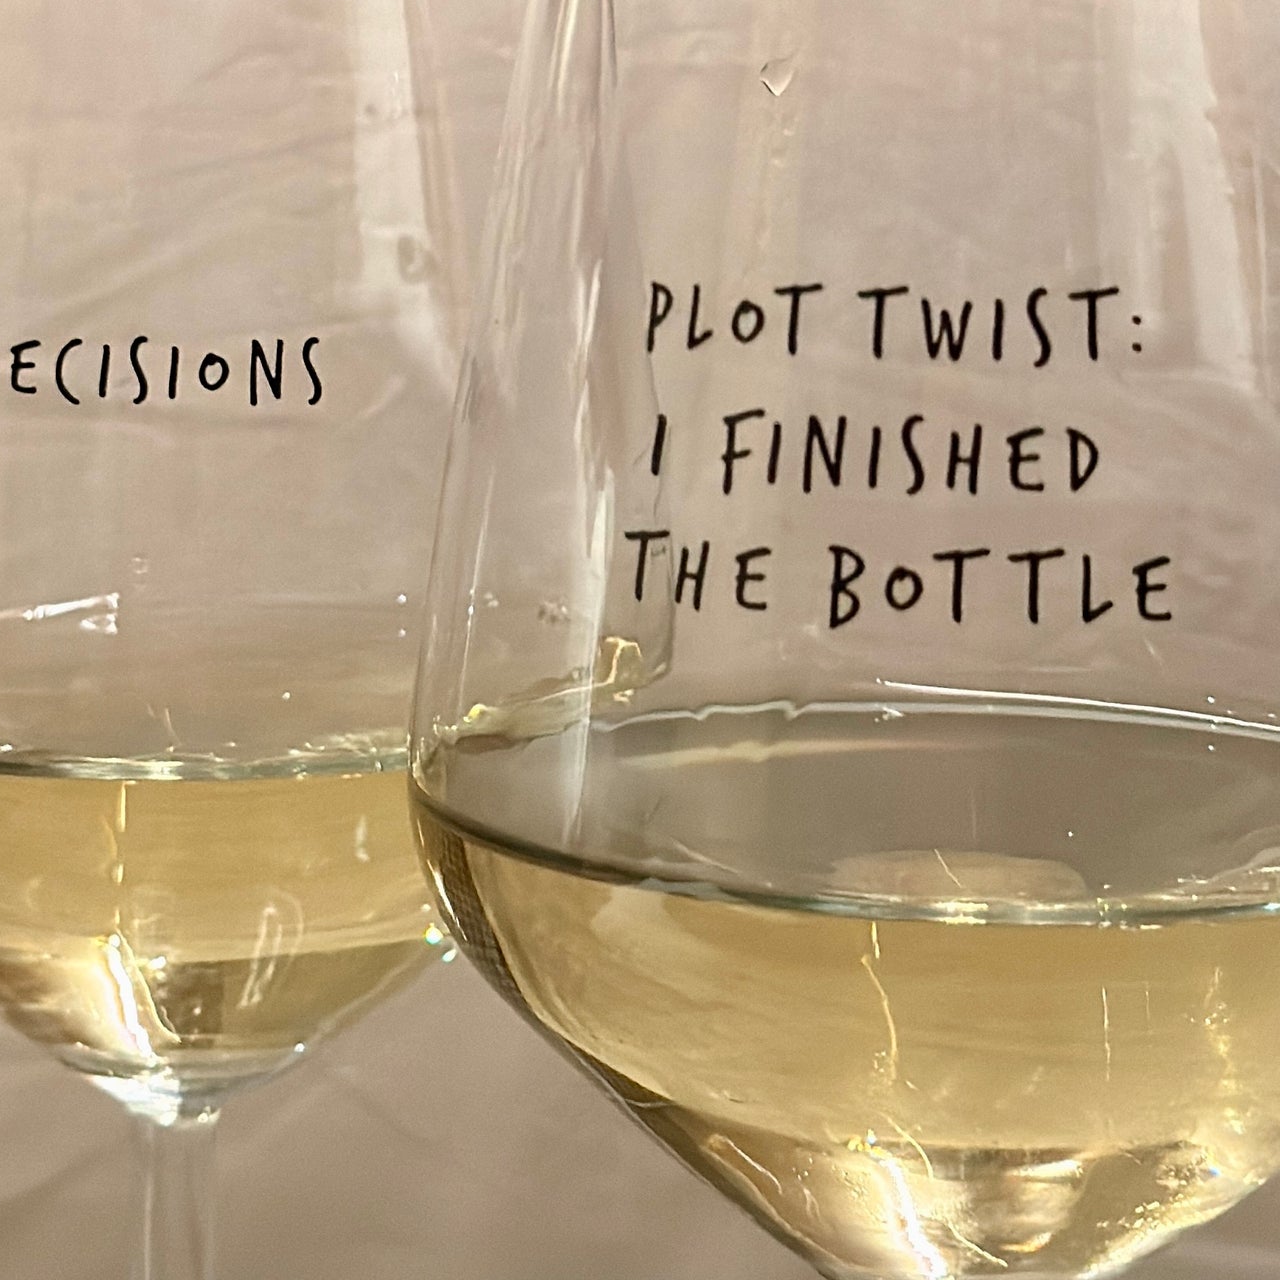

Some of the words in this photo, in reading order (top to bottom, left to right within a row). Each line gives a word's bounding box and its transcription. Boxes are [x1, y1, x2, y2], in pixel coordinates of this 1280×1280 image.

[645, 280, 825, 358] PLOT
[856, 284, 1146, 370] TWIST:
[649, 412, 669, 478] I
[719, 407, 1101, 497] FINISHED
[623, 528, 773, 613] THE
[827, 543, 1174, 630] BOTTLE
